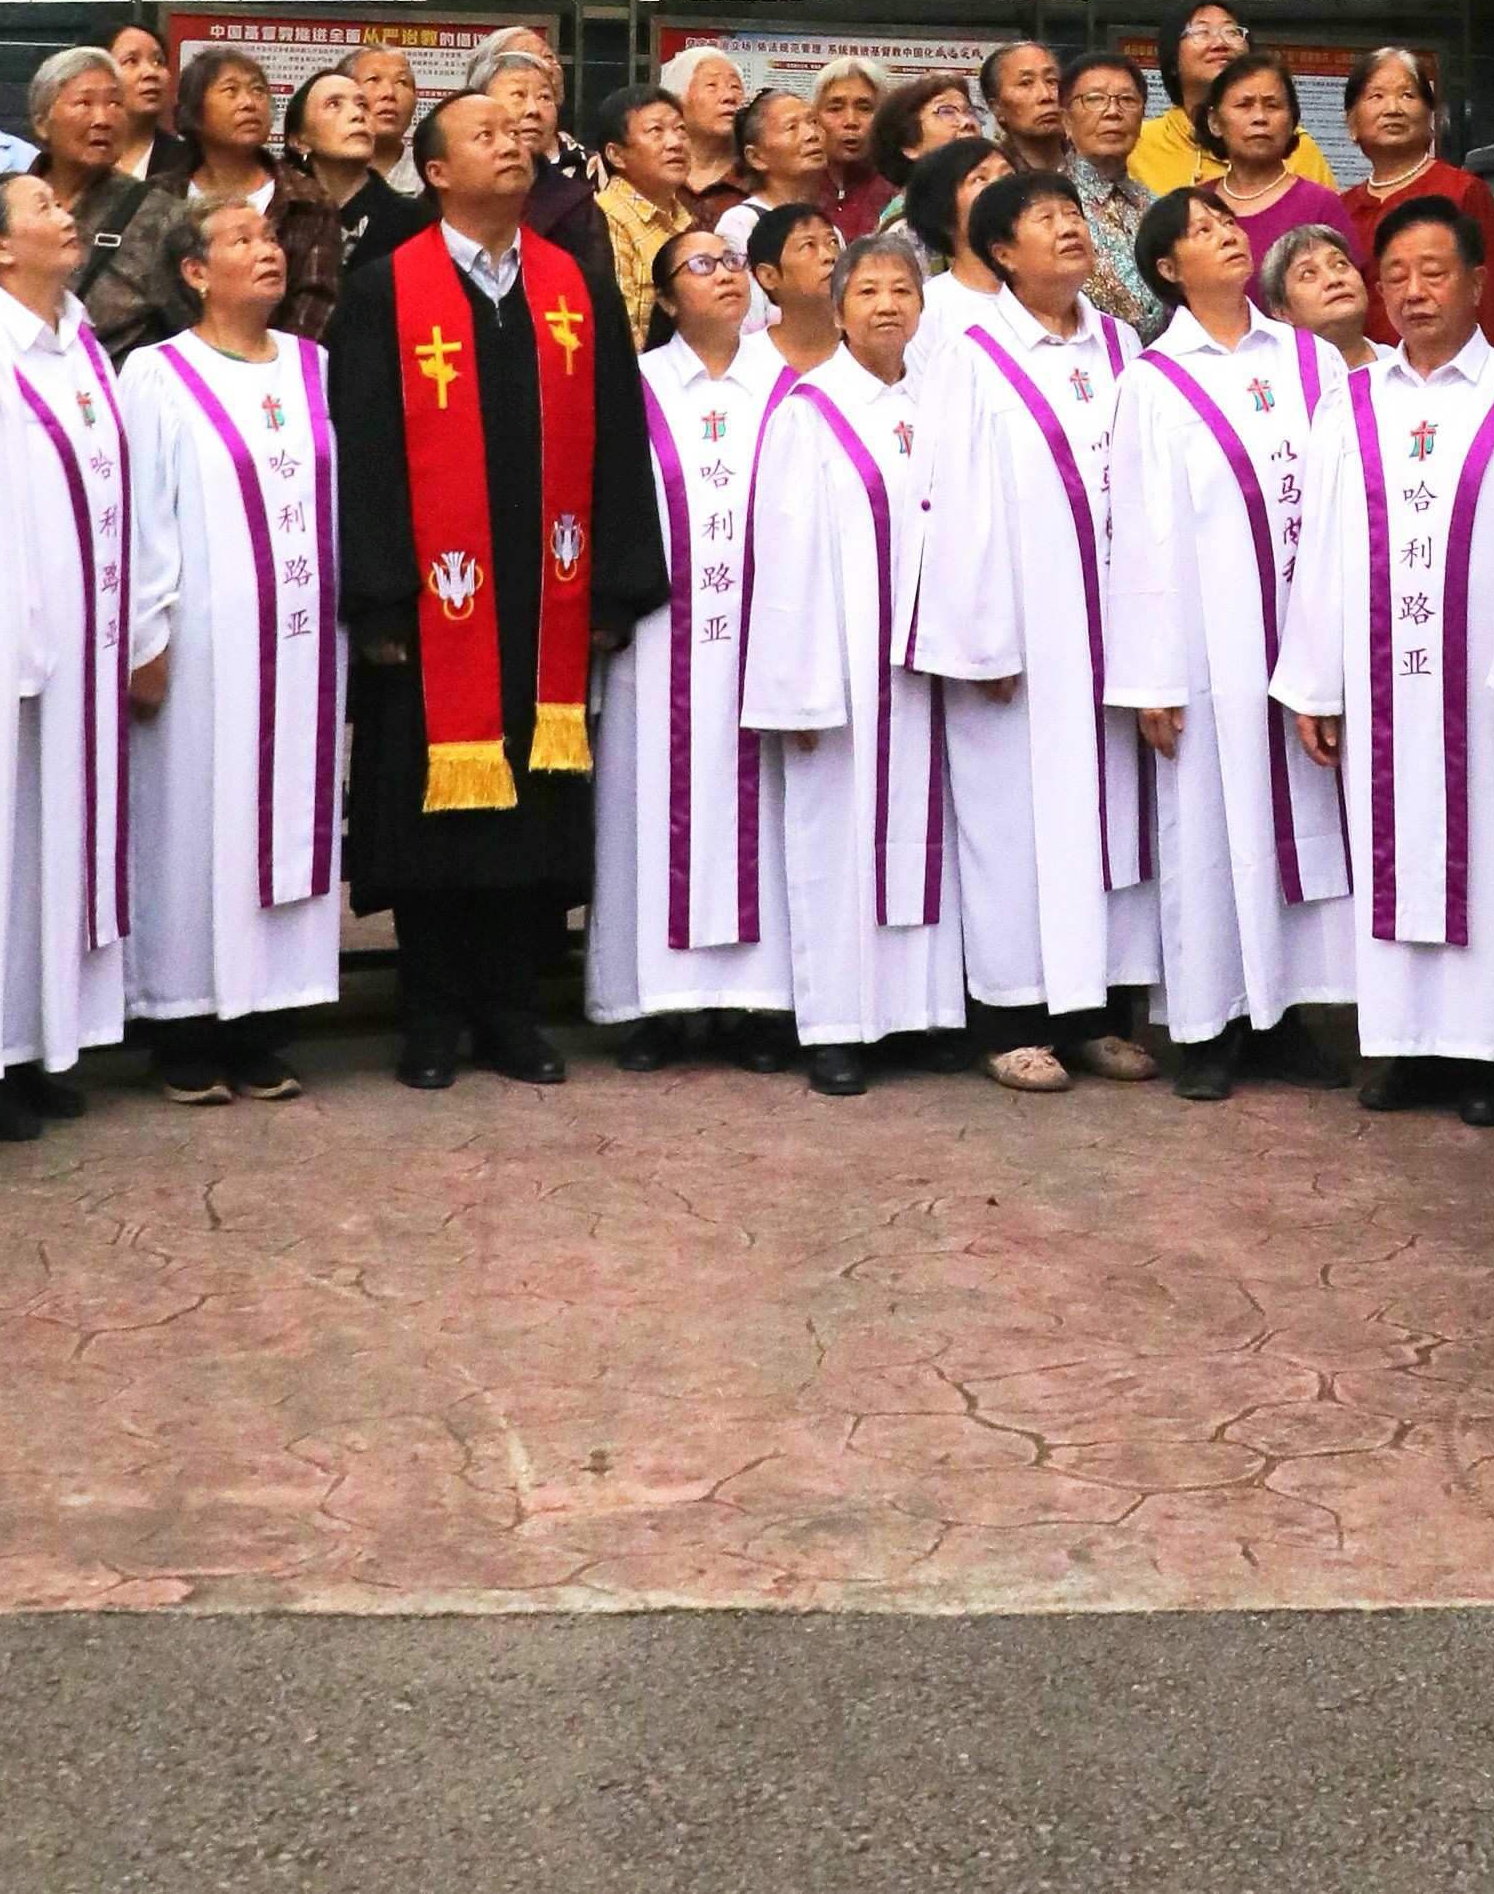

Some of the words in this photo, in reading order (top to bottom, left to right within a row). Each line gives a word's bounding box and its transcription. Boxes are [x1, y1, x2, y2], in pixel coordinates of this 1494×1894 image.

[269, 448, 314, 639] 哈利路亚
[699, 457, 737, 644] 哈利路亚
[1398, 479, 1439, 676] 哈利路亚
